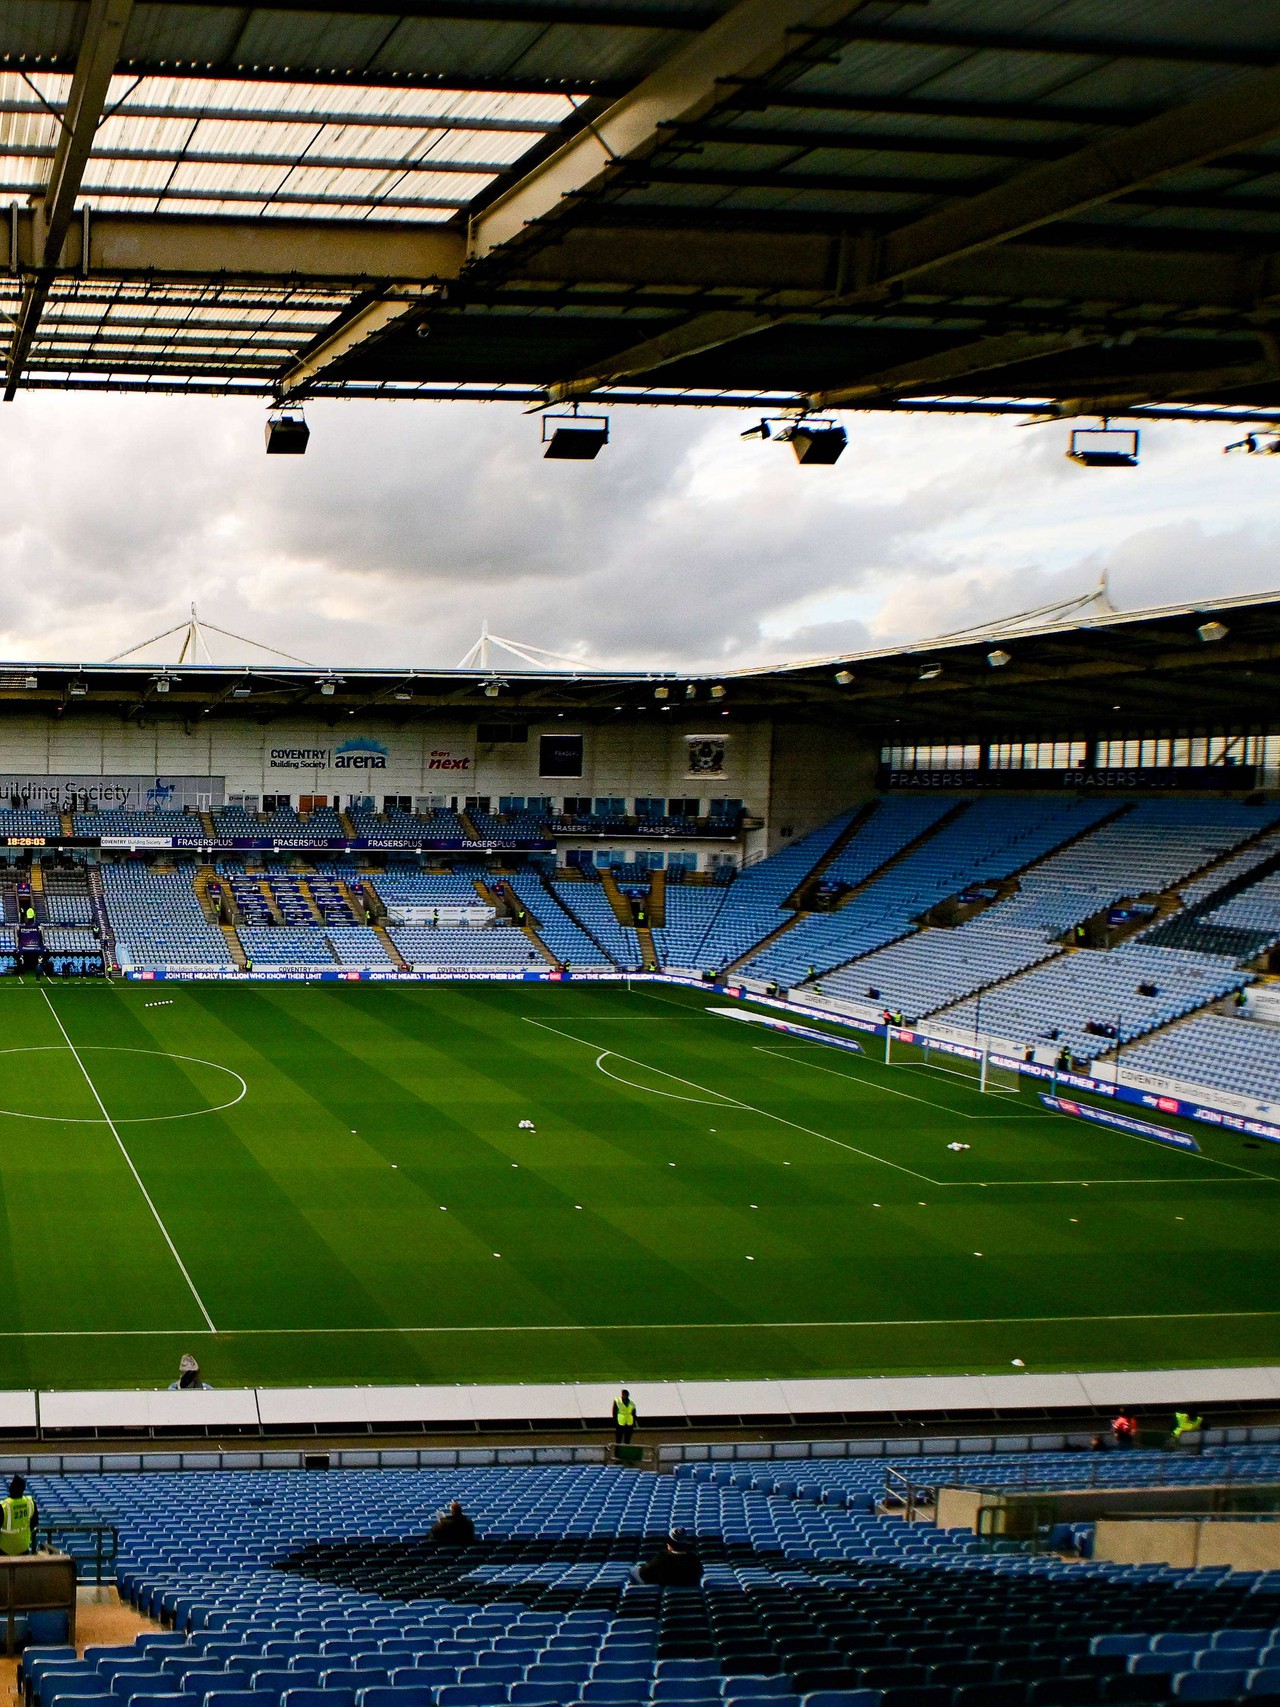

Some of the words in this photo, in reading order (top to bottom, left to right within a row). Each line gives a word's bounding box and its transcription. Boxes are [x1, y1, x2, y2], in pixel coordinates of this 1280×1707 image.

[270, 749, 326, 759] COVENTRY
[270, 760, 299, 769] Building
[300, 760, 326, 770] Society
[334, 754, 386, 768] arena
[428, 756, 470, 770] next
[65, 782, 131, 805] Society
[7, 838, 46, 846] 18:26:03
[177, 838, 234, 846] FRASERSPLUS
[368, 839, 422, 848] FRASERSPLUS
[462, 840, 516, 848] FRASERSPLUS
[1121, 1070, 1170, 1090] COVENTRY
